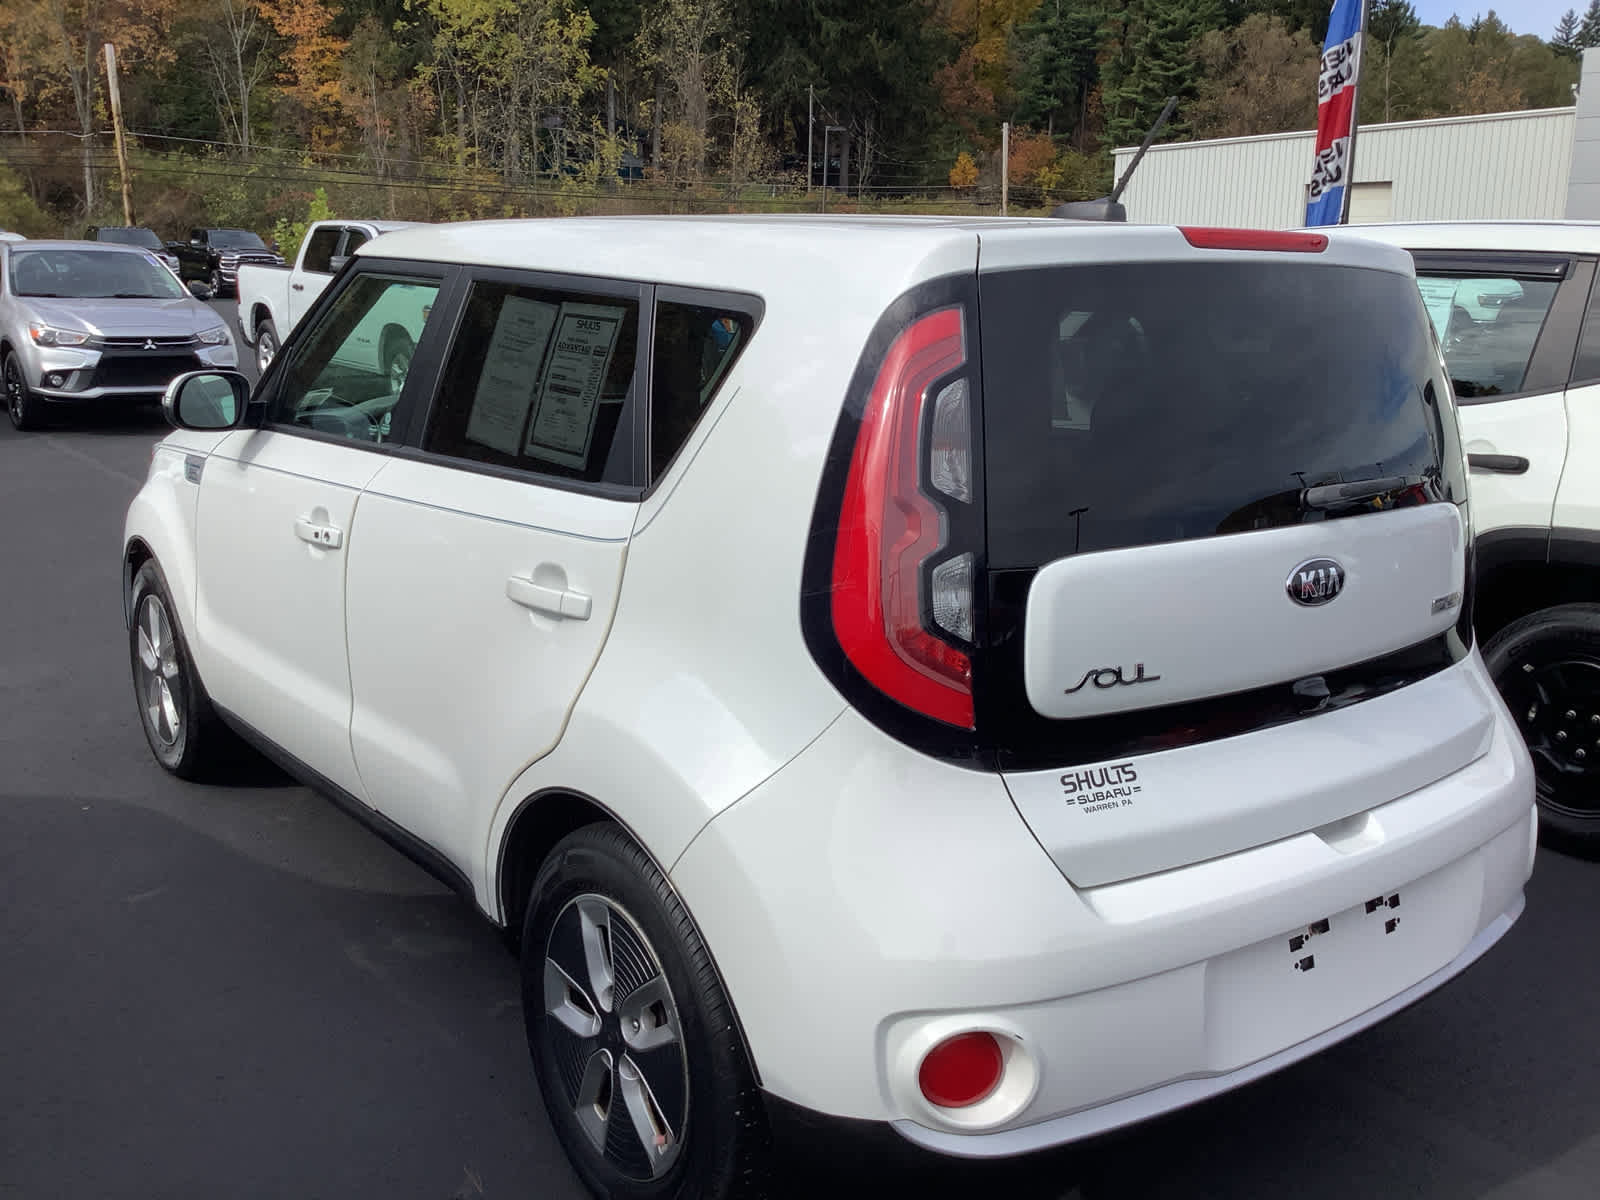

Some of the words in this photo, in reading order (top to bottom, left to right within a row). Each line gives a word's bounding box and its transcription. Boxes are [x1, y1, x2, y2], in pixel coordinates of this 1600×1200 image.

[1299, 567, 1340, 598] KIA
[1064, 663, 1160, 694] SOUL
[1060, 763, 1137, 794] SHULTS
[1083, 801, 1119, 814] WARREN
[1121, 799, 1133, 807] PA
